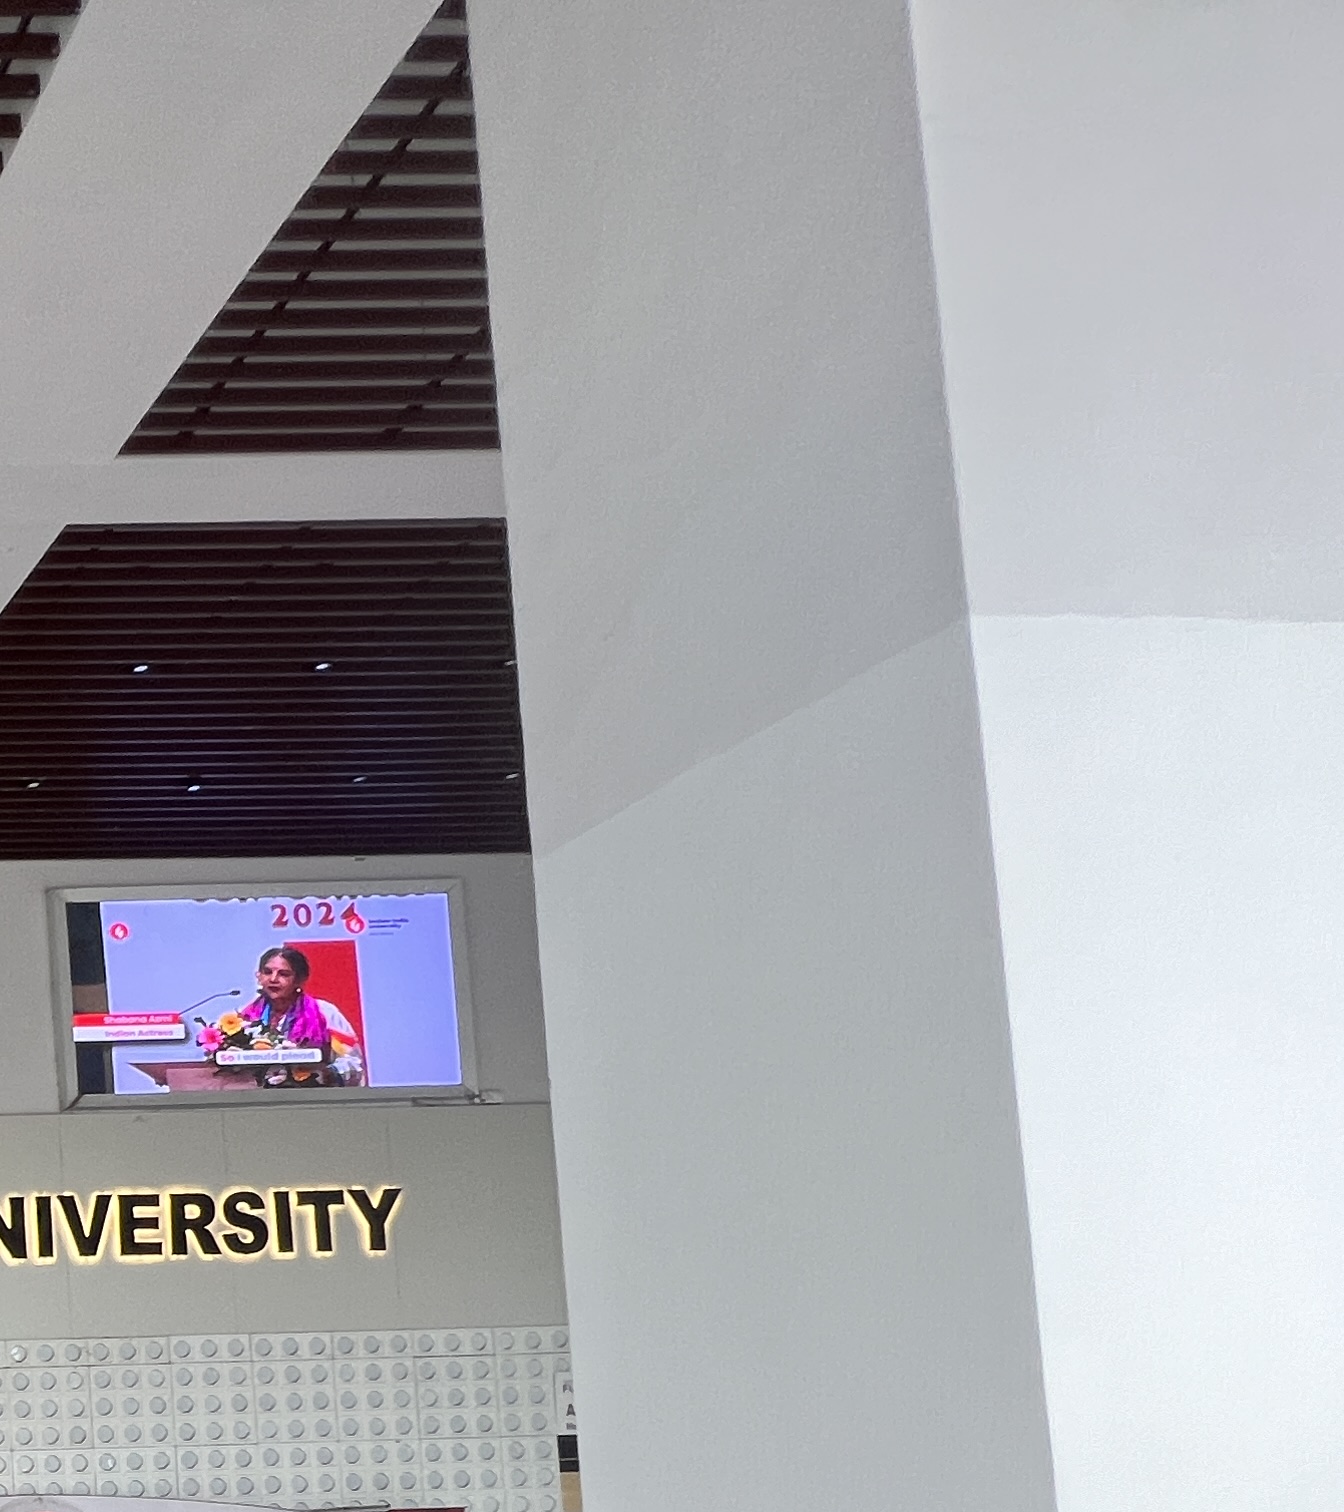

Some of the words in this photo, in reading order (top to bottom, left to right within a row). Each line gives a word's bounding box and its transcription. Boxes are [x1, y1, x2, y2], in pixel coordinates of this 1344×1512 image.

[104, 1030, 136, 1038] Indian
[220, 1053, 235, 1063] So
[243, 1052, 279, 1062] would
